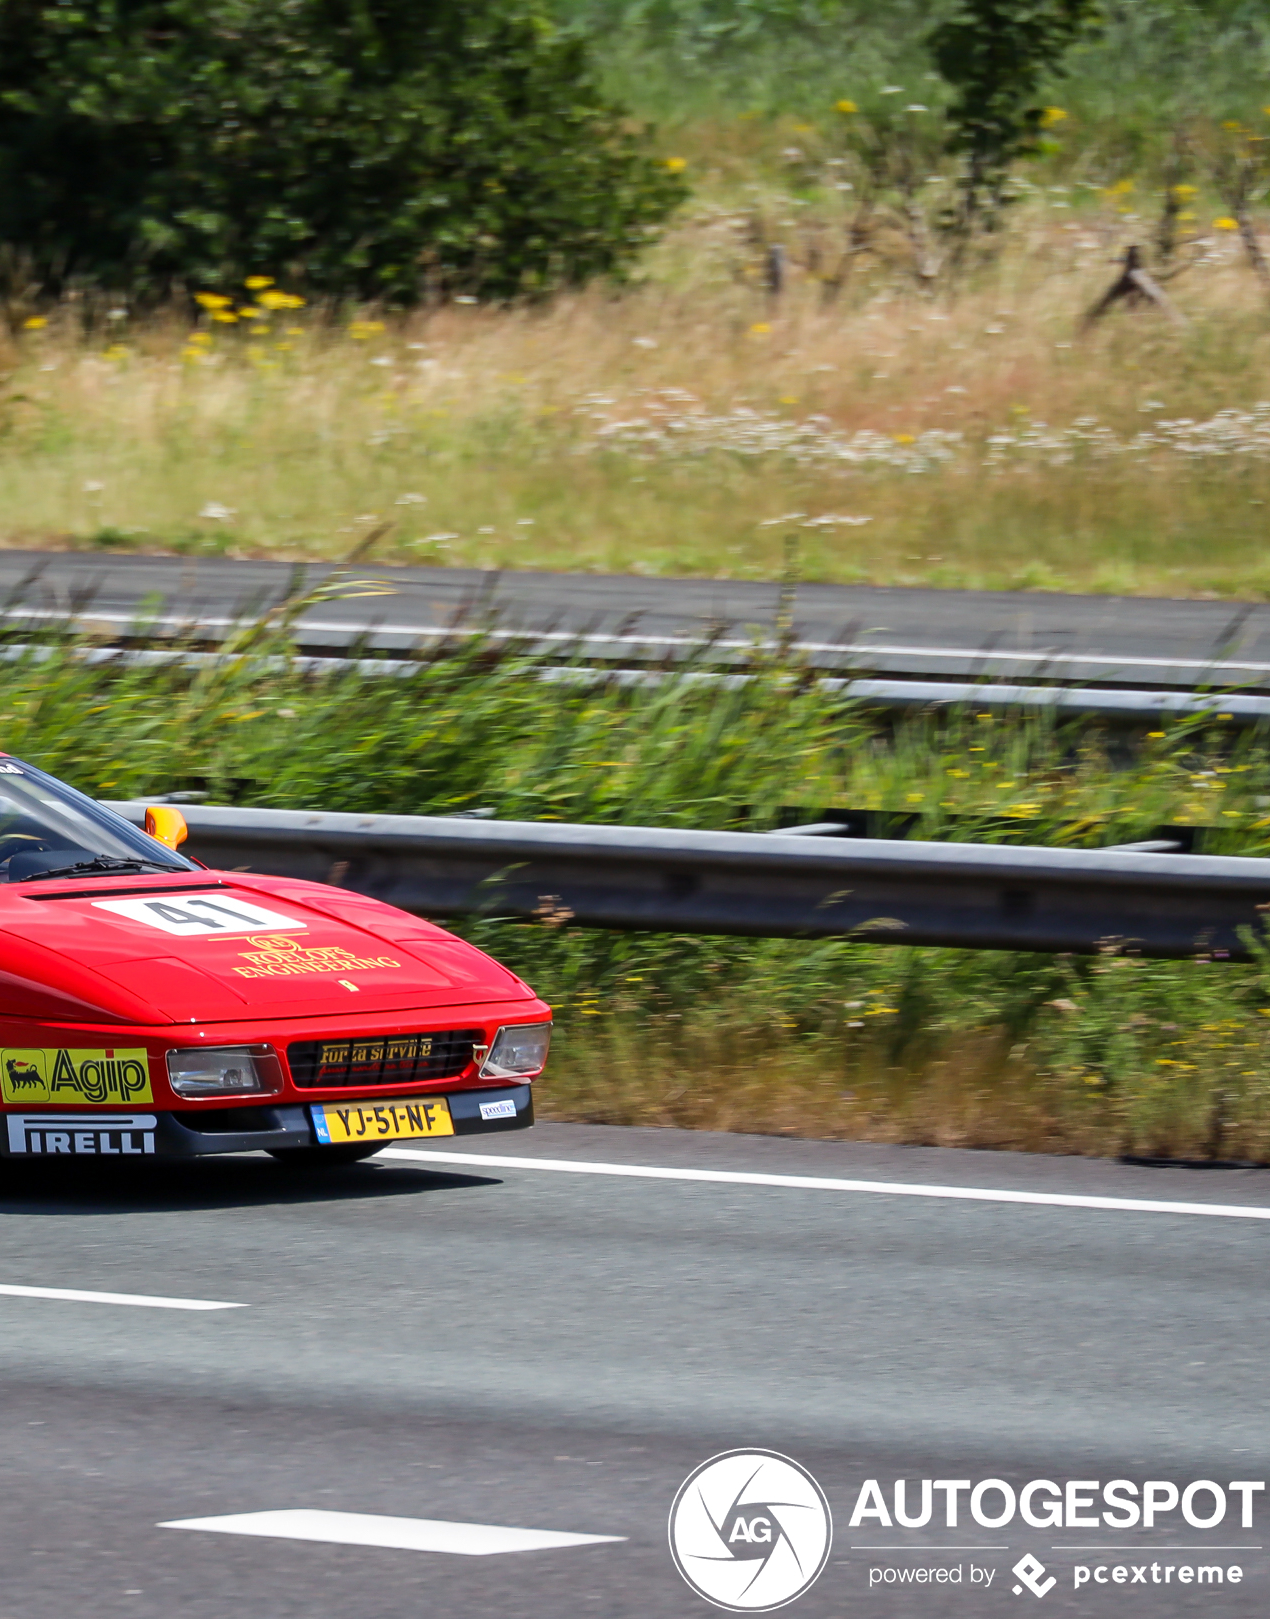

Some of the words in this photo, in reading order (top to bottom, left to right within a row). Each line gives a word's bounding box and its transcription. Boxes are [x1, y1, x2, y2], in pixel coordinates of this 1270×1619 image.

[143, 900, 267, 928] 41
[232, 956, 401, 978] ENGINEERING
[242, 948, 356, 966] ROELOFS
[51, 1049, 146, 1103] Agip
[6, 1114, 157, 1153] PIRELLI
[317, 1127, 328, 1137] NL
[336, 1104, 436, 1136] YJ-51-NF
